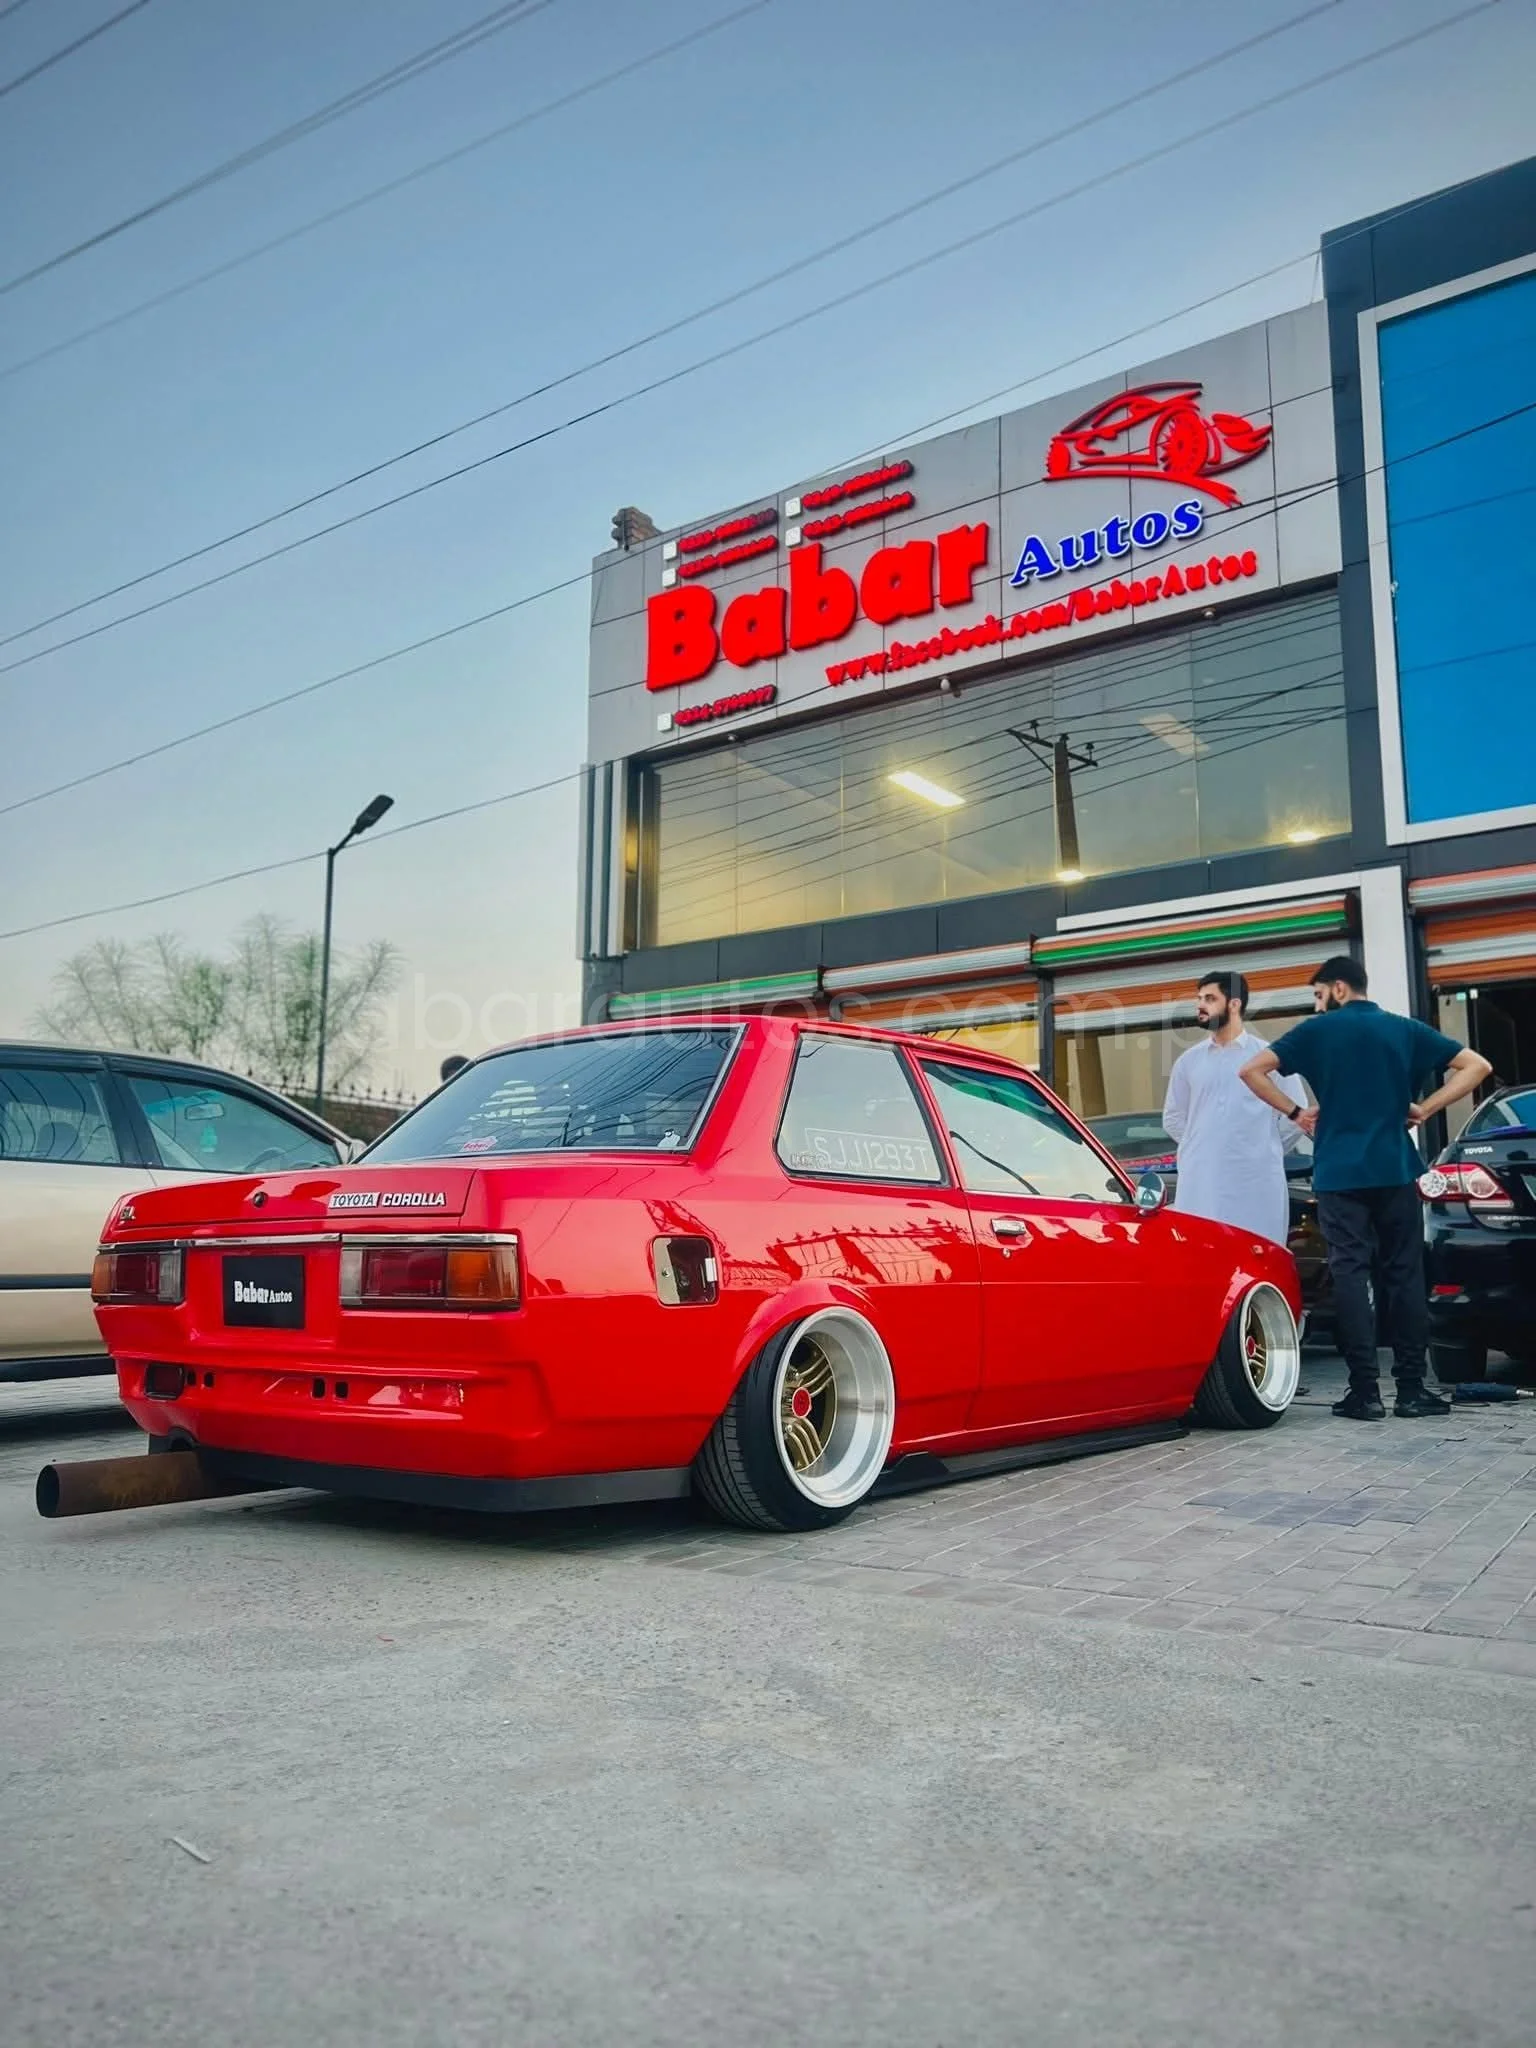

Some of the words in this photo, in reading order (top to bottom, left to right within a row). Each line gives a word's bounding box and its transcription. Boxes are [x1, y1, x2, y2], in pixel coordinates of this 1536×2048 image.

[646, 522, 991, 693] Babar
[1008, 498, 1206, 588] Autos
[813, 1136, 928, 1173] SJJ1293T
[1464, 1146, 1493, 1155] TOYOTA
[332, 1194, 374, 1207] TOYOTA
[381, 1192, 447, 1207] COROLLA
[234, 1280, 269, 1303] Babar
[269, 1289, 293, 1303] Autos
